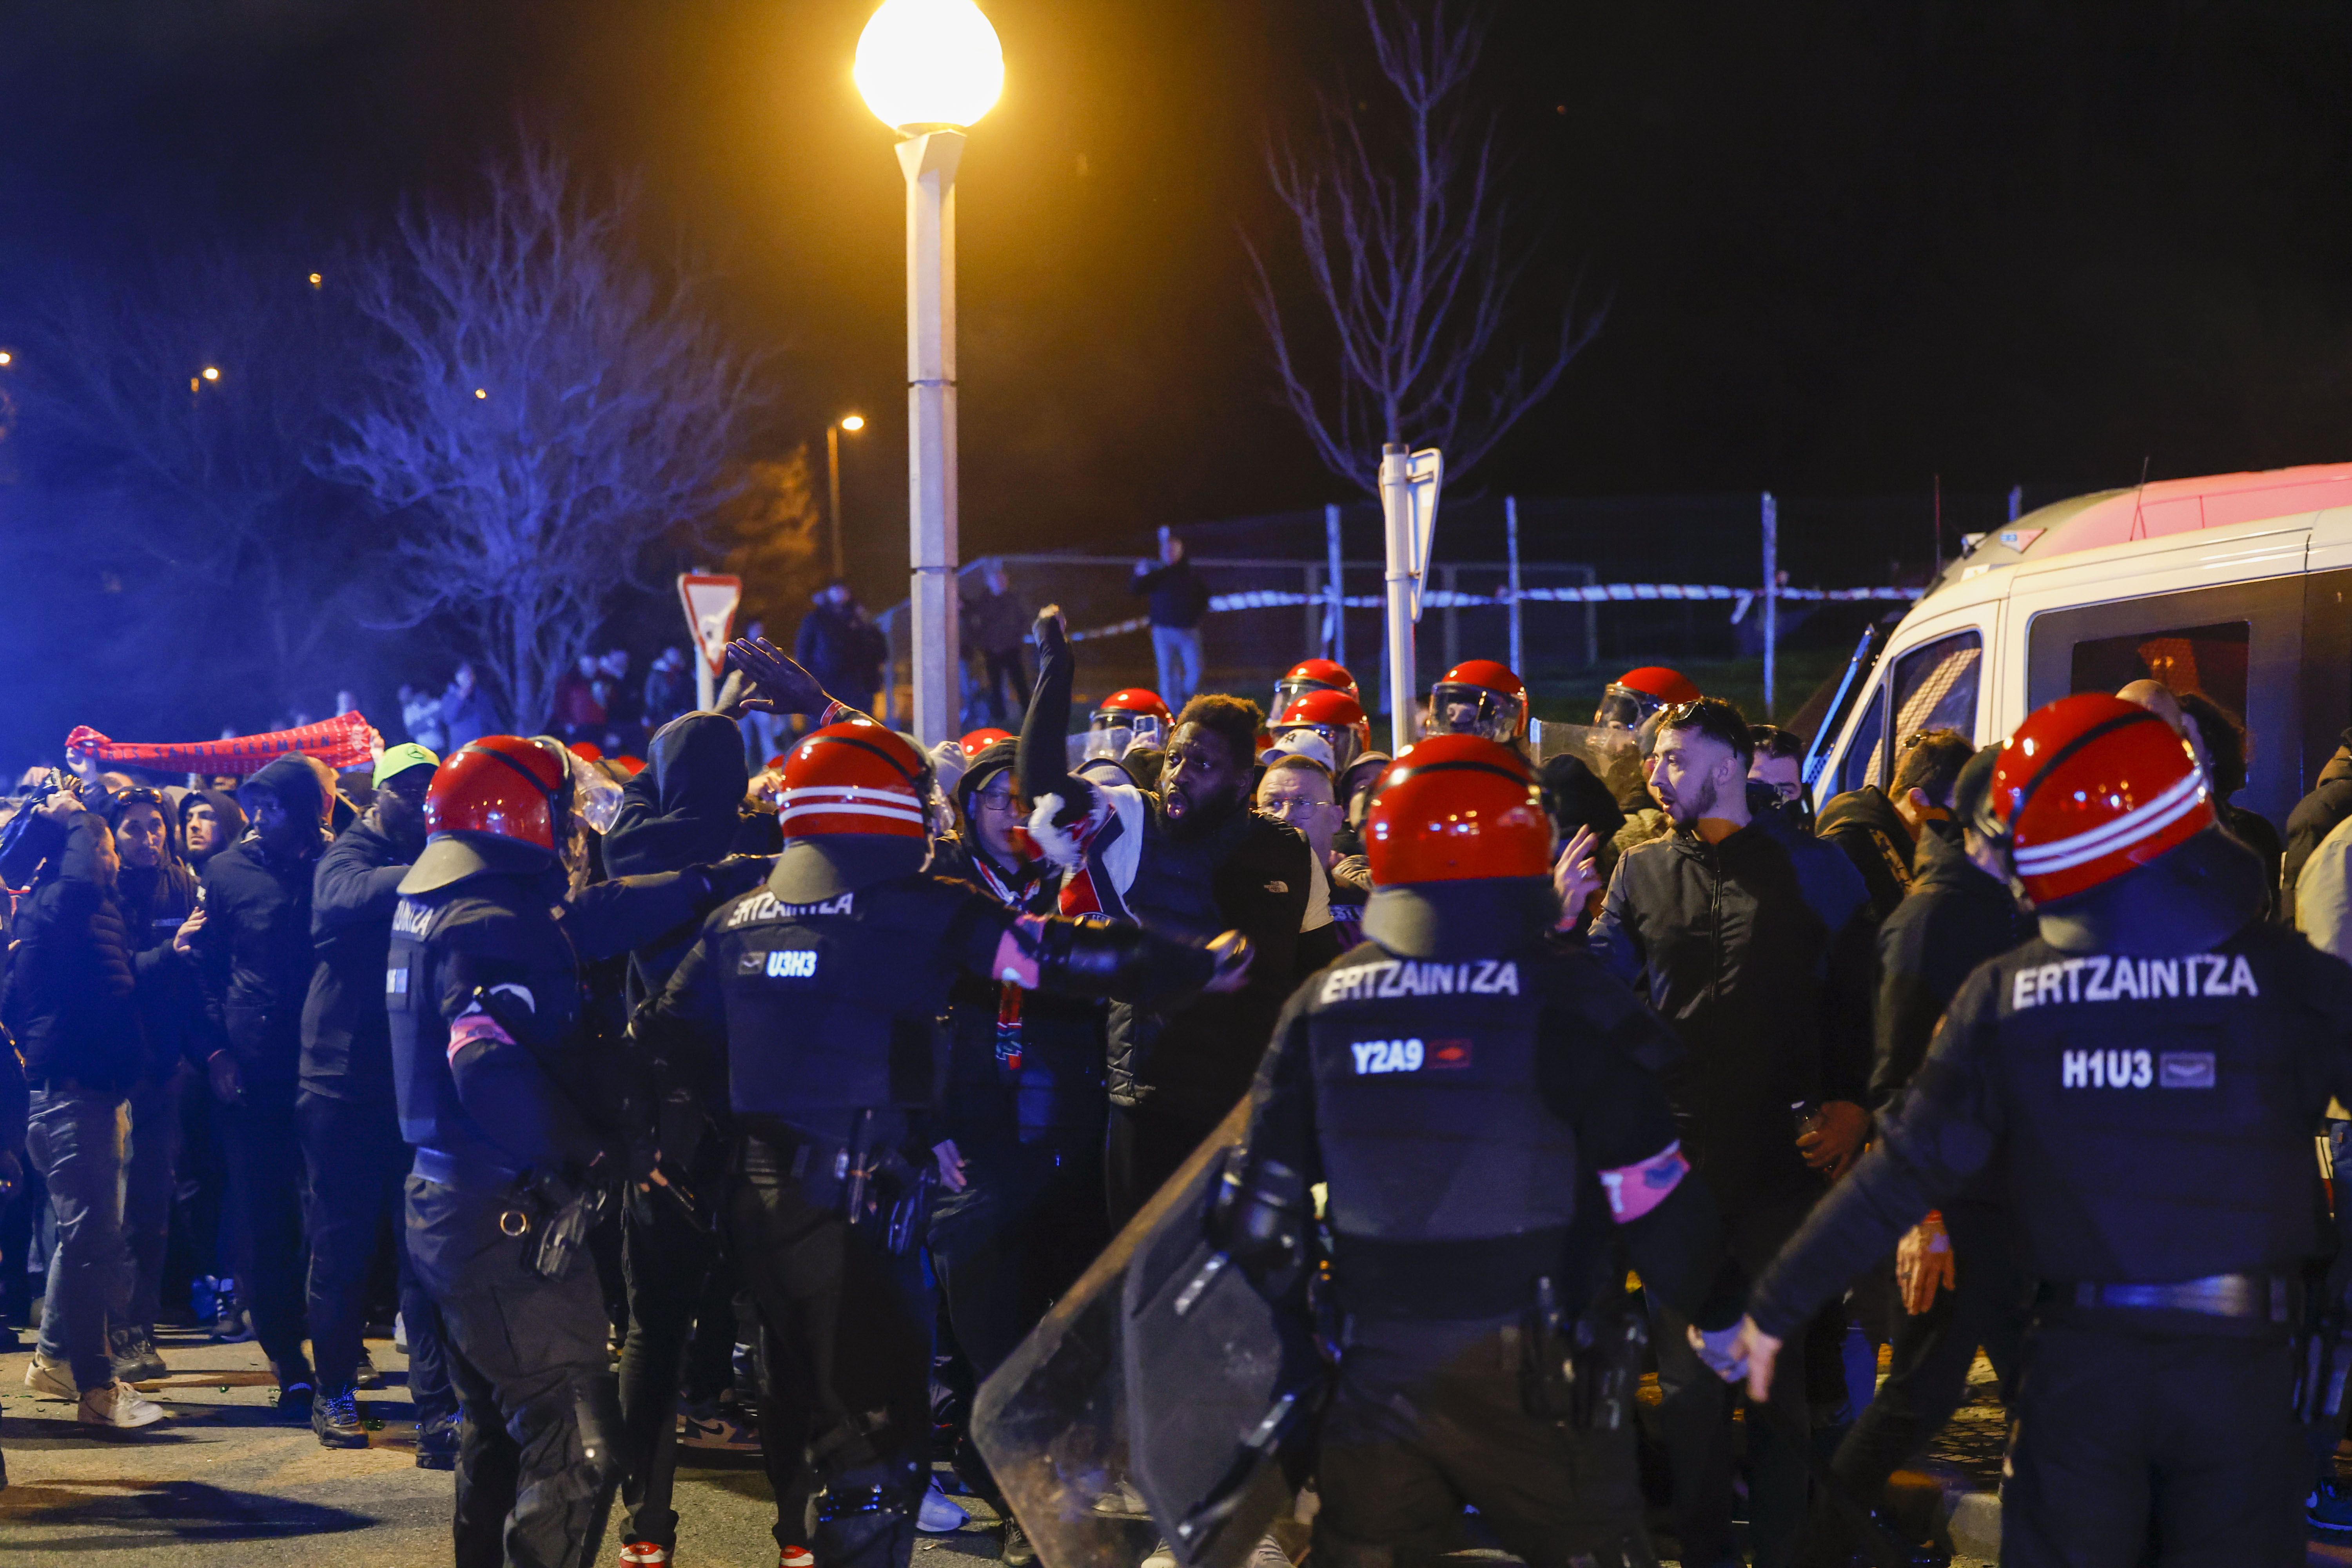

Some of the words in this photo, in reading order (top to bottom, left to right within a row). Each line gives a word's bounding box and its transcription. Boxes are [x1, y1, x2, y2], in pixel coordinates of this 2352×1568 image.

[767, 951, 817, 978] U3H3
[2013, 954, 2259, 1010] ERTZAINTZA
[1351, 1038, 1424, 1075] Y2A9
[2062, 1049, 2153, 1089] H1U3
